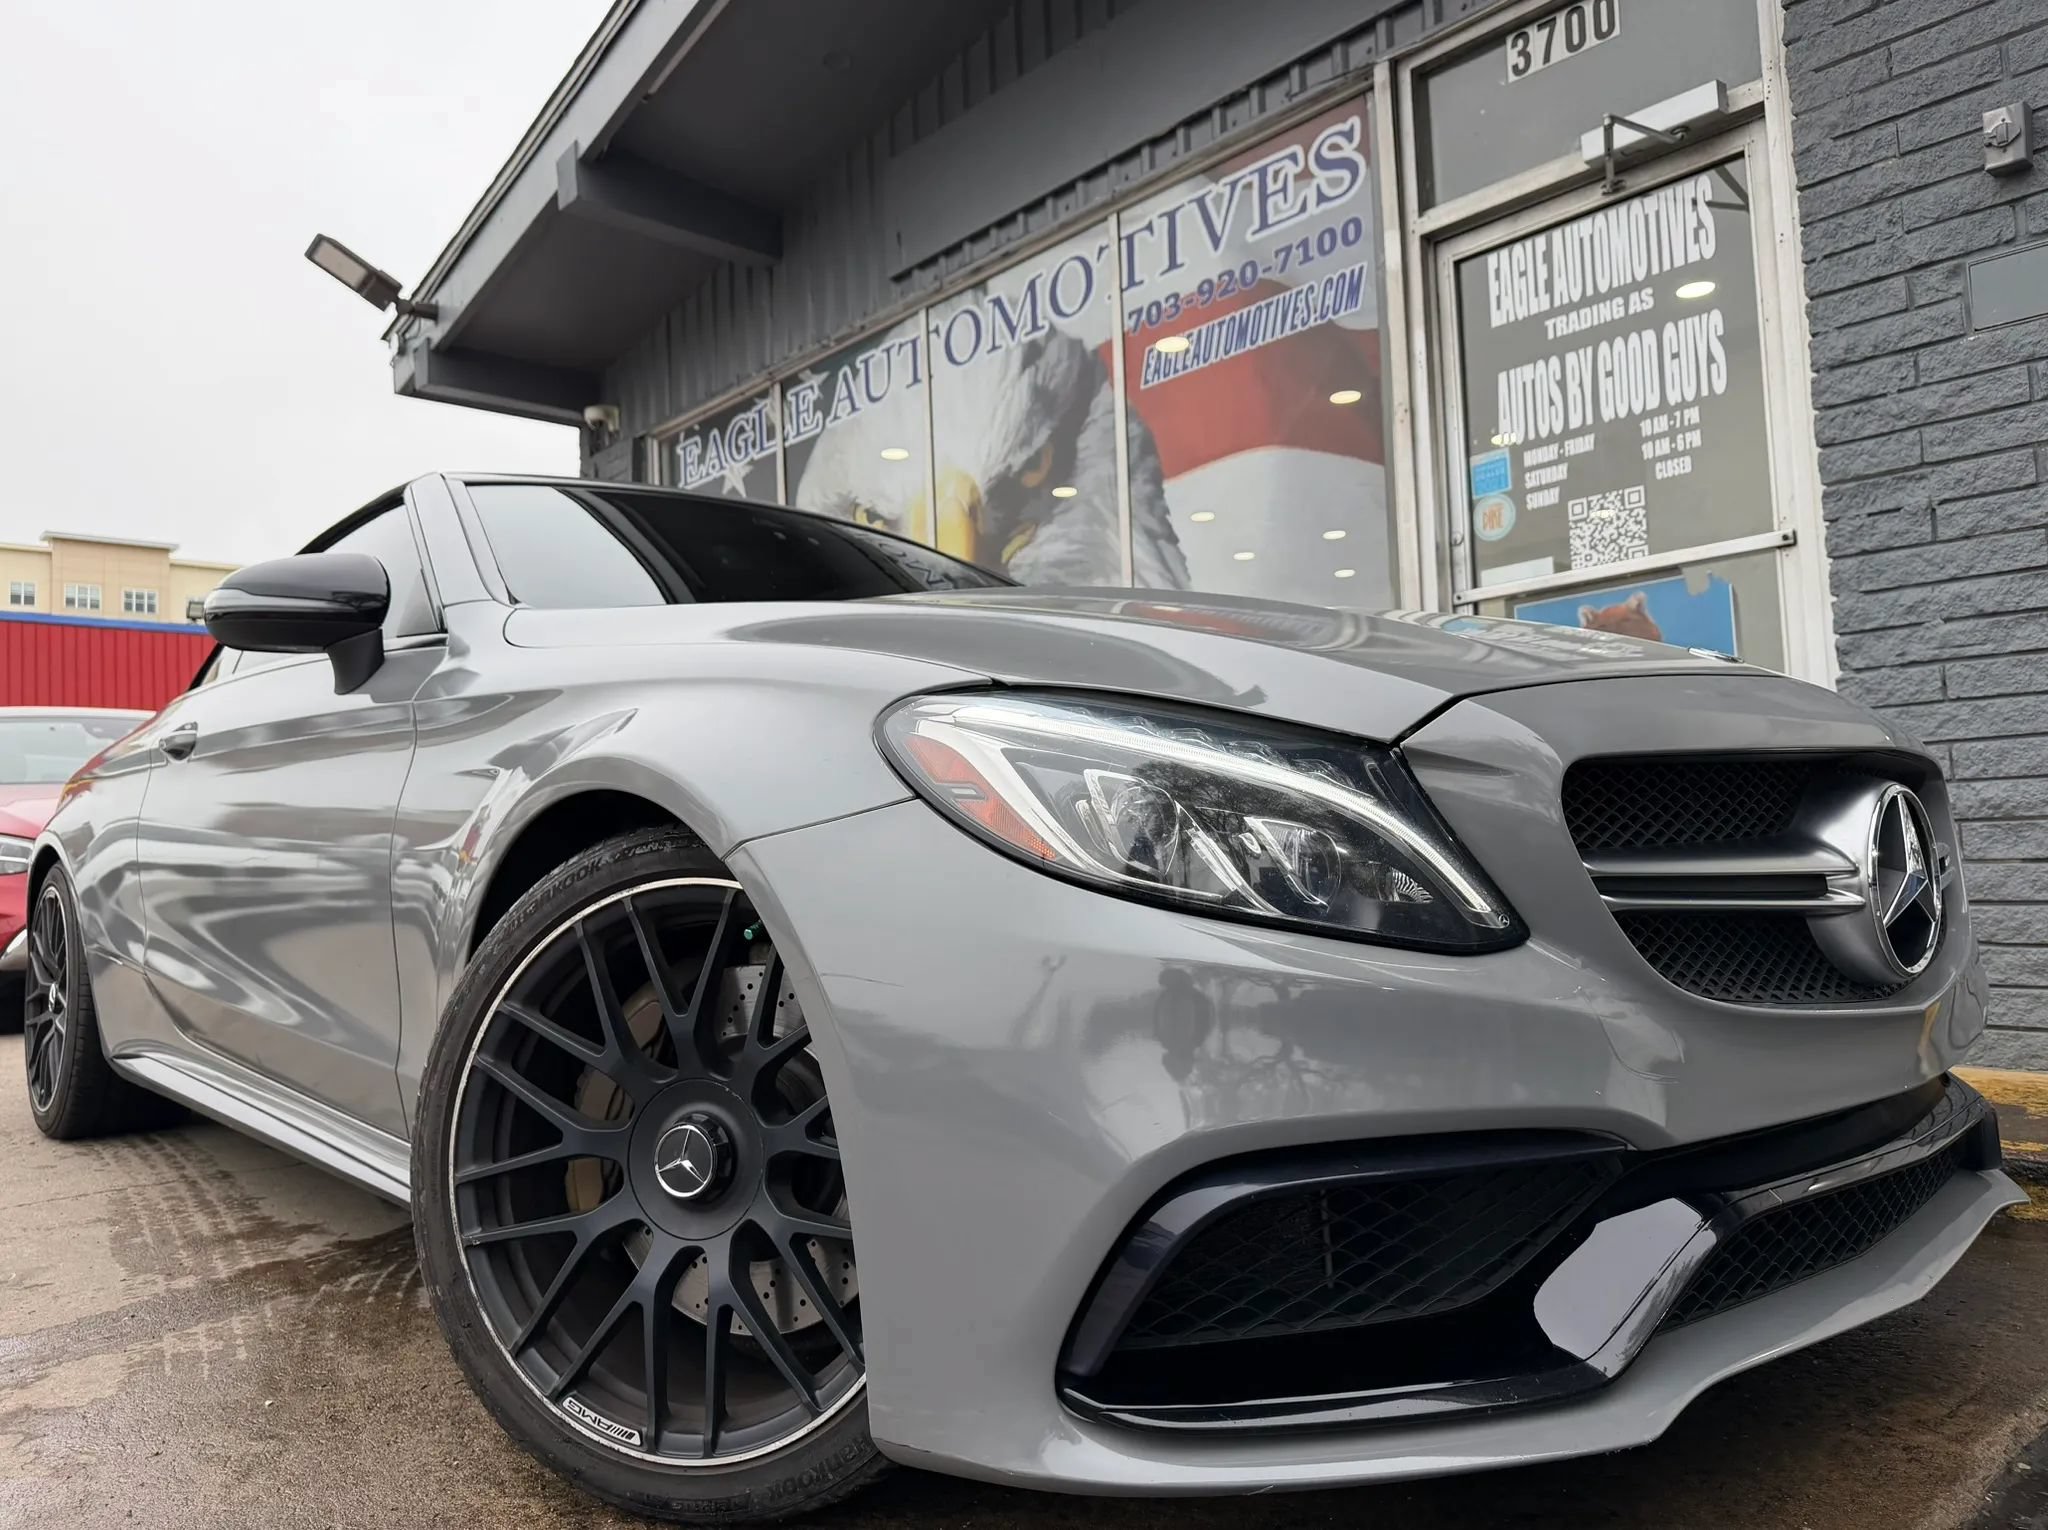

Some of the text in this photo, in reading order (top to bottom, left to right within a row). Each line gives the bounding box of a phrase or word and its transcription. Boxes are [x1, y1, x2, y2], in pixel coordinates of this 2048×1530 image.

[1511, 0, 1616, 77] 3700
[1127, 216, 1363, 335] 703-920-7100
[1487, 174, 1716, 328] EAGLE AUTOMOTIVES
[679, 117, 1367, 488] EAGLE AUTOMOTIVES
[1141, 263, 1366, 388] EAGLEAUTOMOTIVES.COM
[1544, 287, 1654, 340] TRADING AS
[1497, 308, 1728, 446] AUTOS BY GOOD GUYS
[1524, 462, 1569, 489] SATURDAY
[1685, 428, 1702, 450] PM
[1564, 433, 1596, 457] FRIDAY
[1673, 410, 1681, 428] 7
[1683, 405, 1700, 427] PM
[1525, 455, 1692, 511] SUNDAY CLOSED
